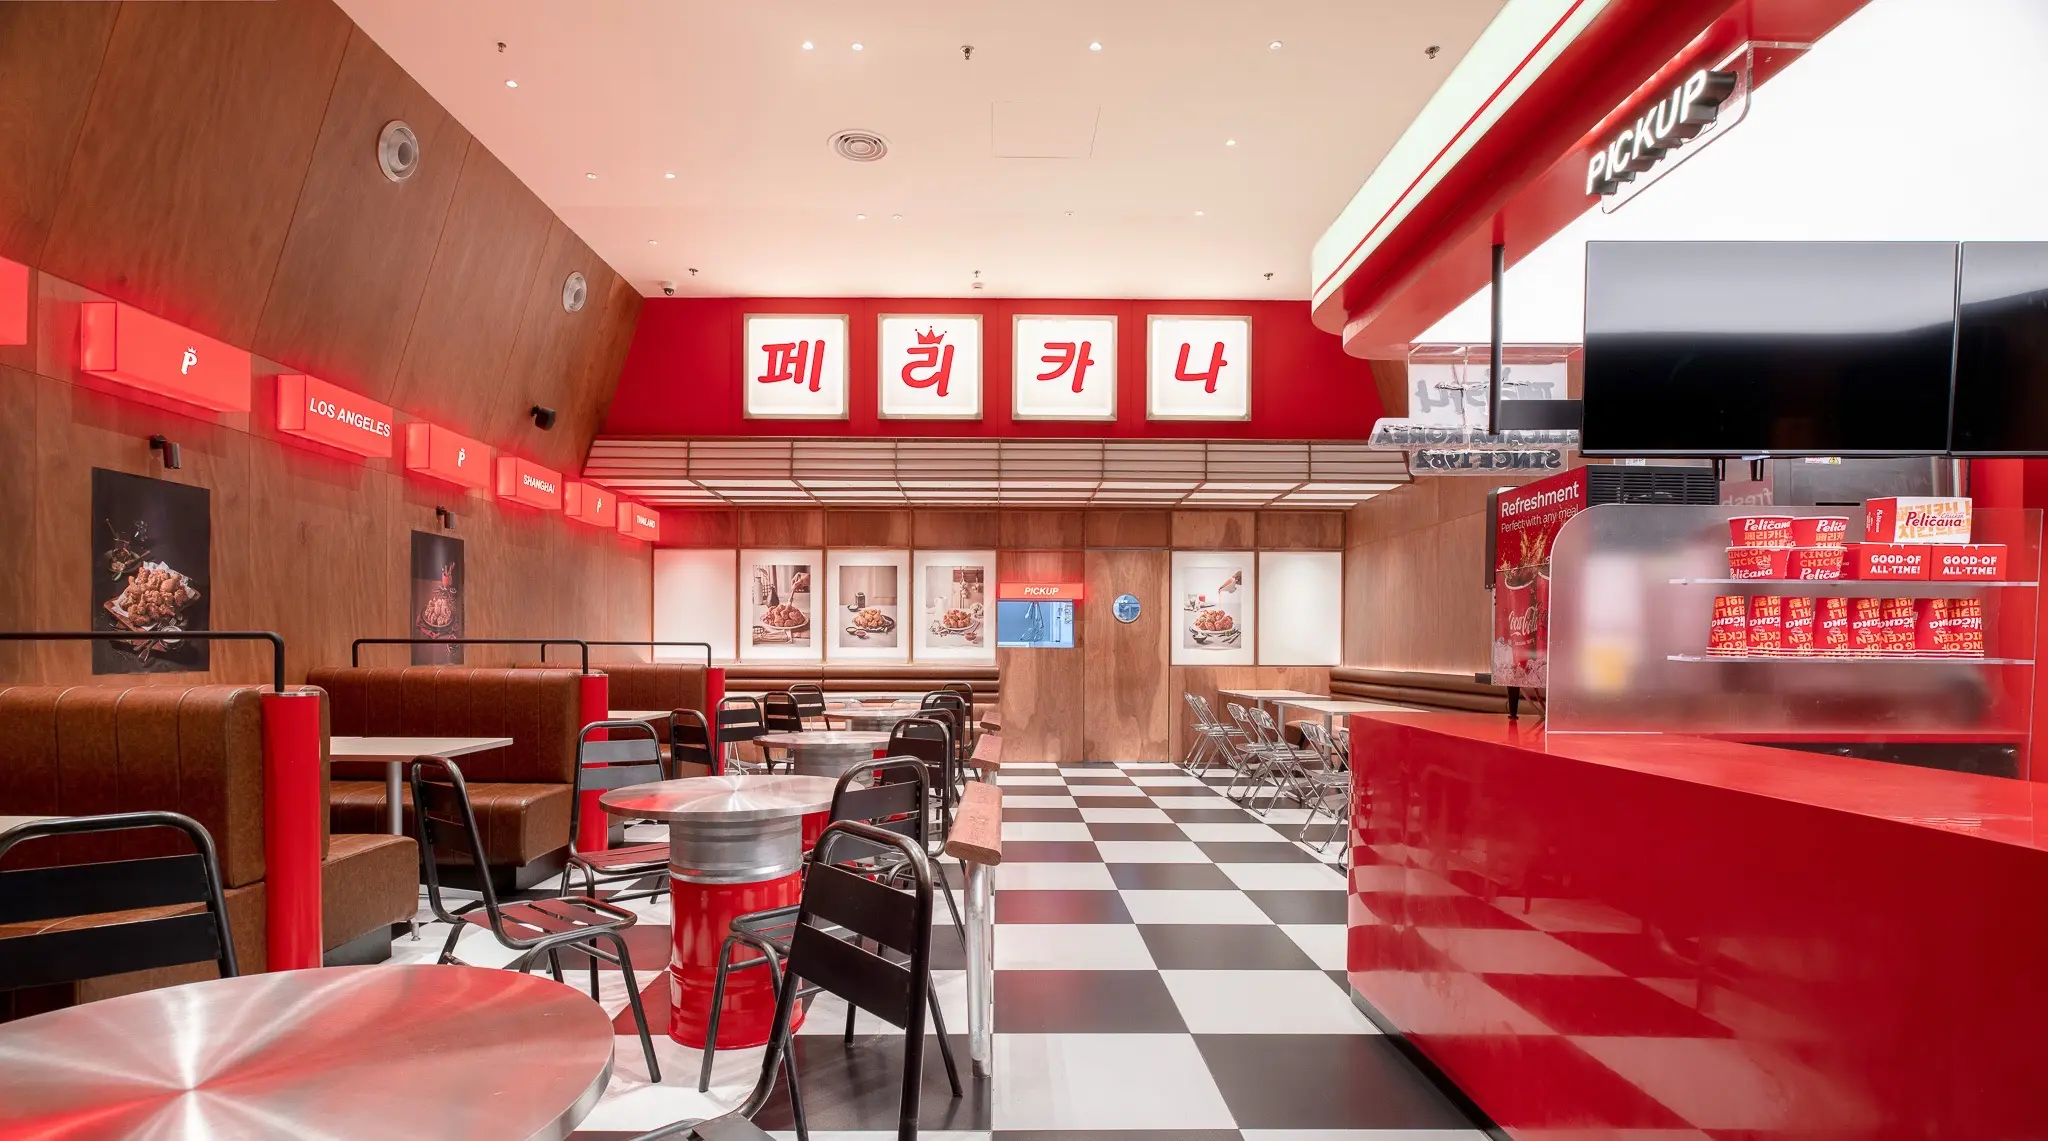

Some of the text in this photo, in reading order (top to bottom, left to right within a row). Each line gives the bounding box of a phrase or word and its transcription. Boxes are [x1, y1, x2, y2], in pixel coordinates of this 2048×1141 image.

[1586, 69, 1708, 195] PICKUP
[309, 397, 391, 437] LOS ANGELES
[523, 474, 556, 494] SHANGHAI
[1501, 481, 1580, 518] Refreshment
[636, 514, 656, 529] THAILAND
[1501, 504, 1579, 534] Perfect with any meal
[1905, 511, 1962, 527] Pelicana
[1800, 551, 1832, 559] KING
[1870, 554, 1922, 564] GOOD-OF
[1943, 555, 1997, 565] GOOD-OF
[1870, 565, 1921, 575] ALL-TIME!
[1942, 566, 1997, 575] ALL-TIME!
[1024, 587, 1059, 596] PICKUP
